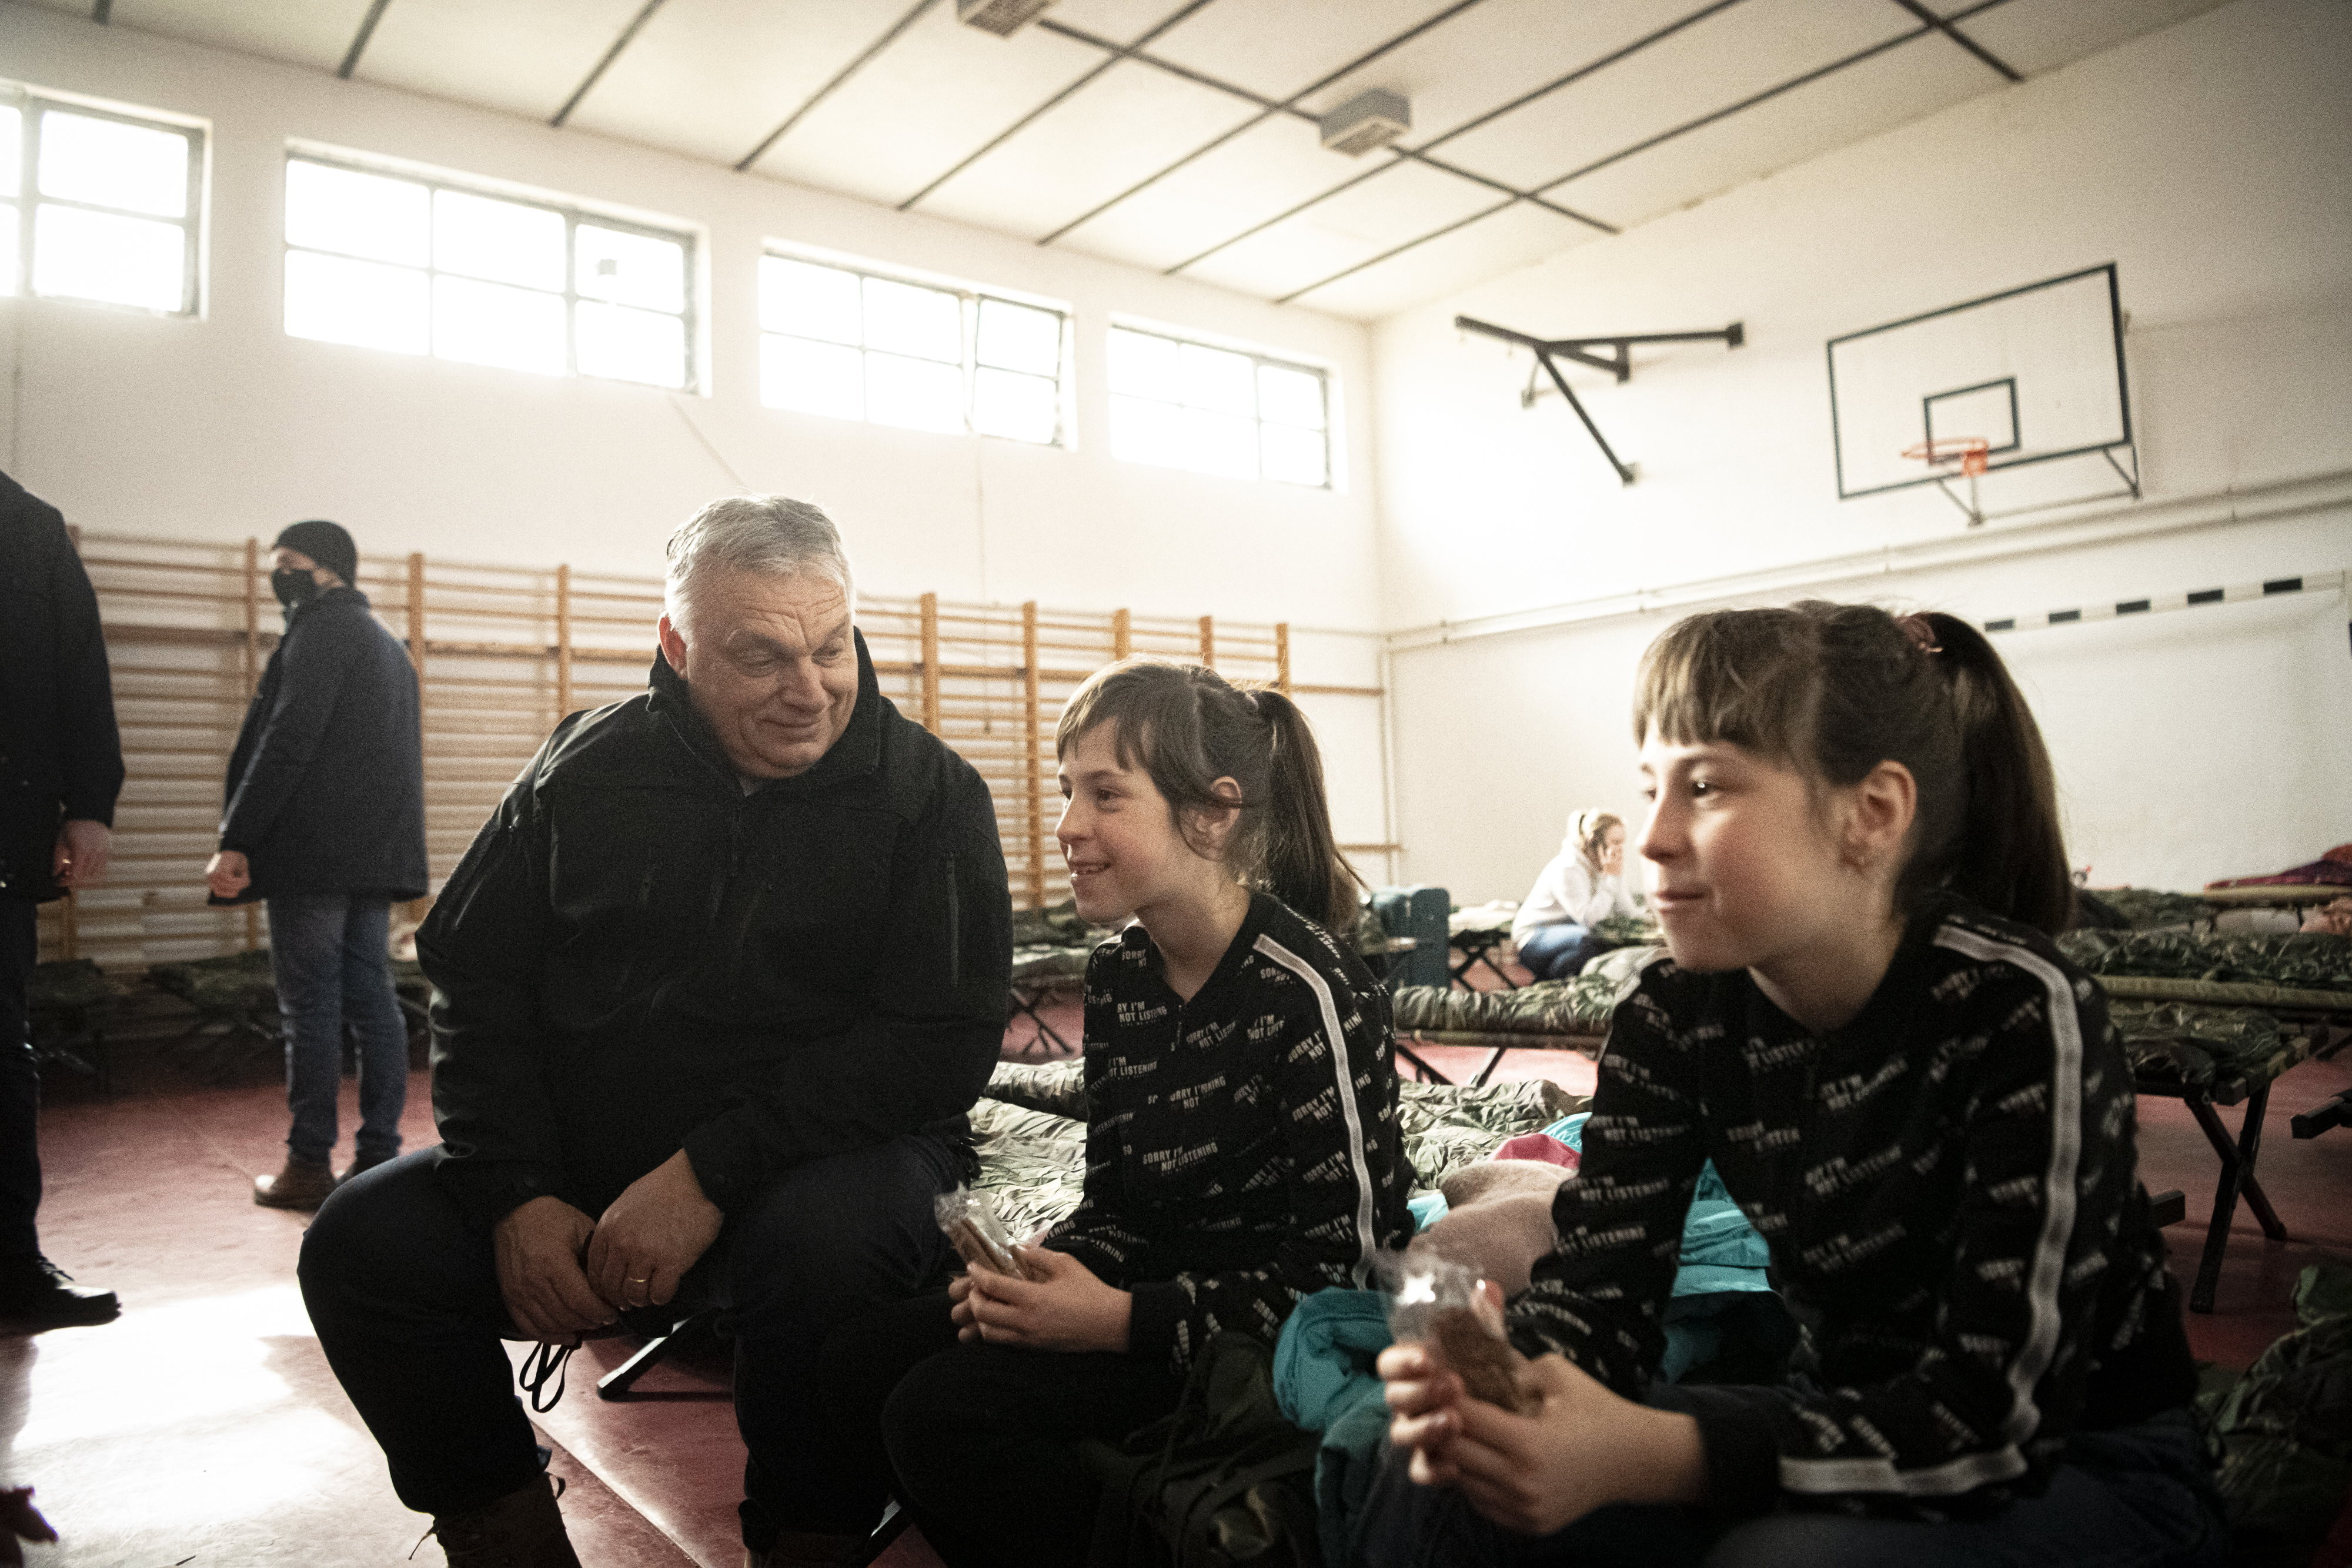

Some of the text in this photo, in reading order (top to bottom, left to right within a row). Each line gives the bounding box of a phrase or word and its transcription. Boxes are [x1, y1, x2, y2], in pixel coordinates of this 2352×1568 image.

[1131, 1001, 1145, 1011] I'M
[1119, 1012, 1136, 1023] NOT
[1198, 1036, 1215, 1049] NOT
[1288, 1037, 1314, 1063] SORRY
[1308, 1041, 1327, 1060] NOT
[1113, 1057, 1127, 1066] I'M
[1182, 1096, 1200, 1110] NOT
[1292, 1098, 1319, 1122] SORRY
[1313, 1101, 1333, 1121] NOT
[1142, 1148, 1170, 1165] SORRY
[1161, 1158, 1176, 1172] NOT
[1302, 1162, 1329, 1183] SORRY
